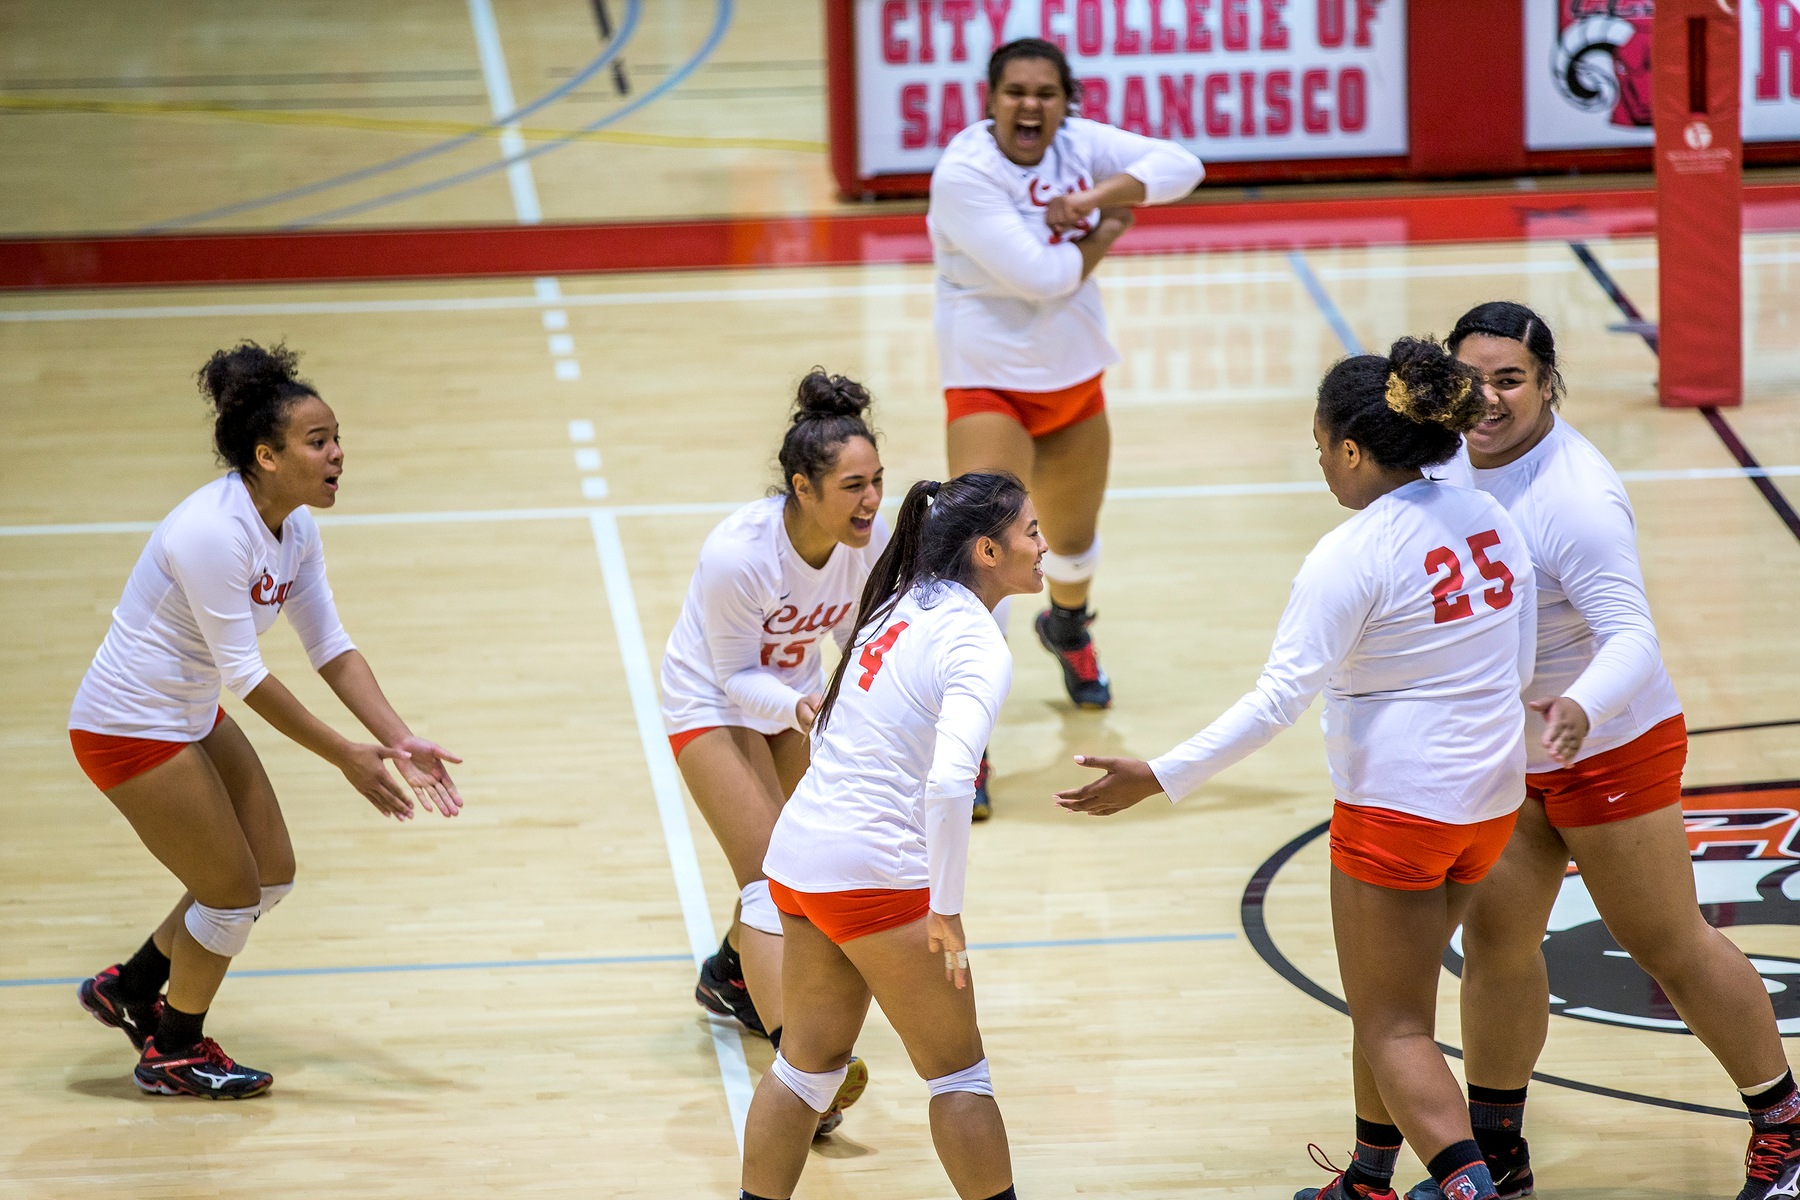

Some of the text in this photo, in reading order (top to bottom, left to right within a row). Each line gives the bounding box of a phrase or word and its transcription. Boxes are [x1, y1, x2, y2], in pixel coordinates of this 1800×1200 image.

[882, 0, 1386, 65] CITY COLLEGE OF
[1080, 67, 1366, 138] RANCISCO
[1424, 529, 1515, 625] 25
[761, 637, 816, 668] 15
[763, 602, 853, 635] City
[858, 620, 909, 692] 4
